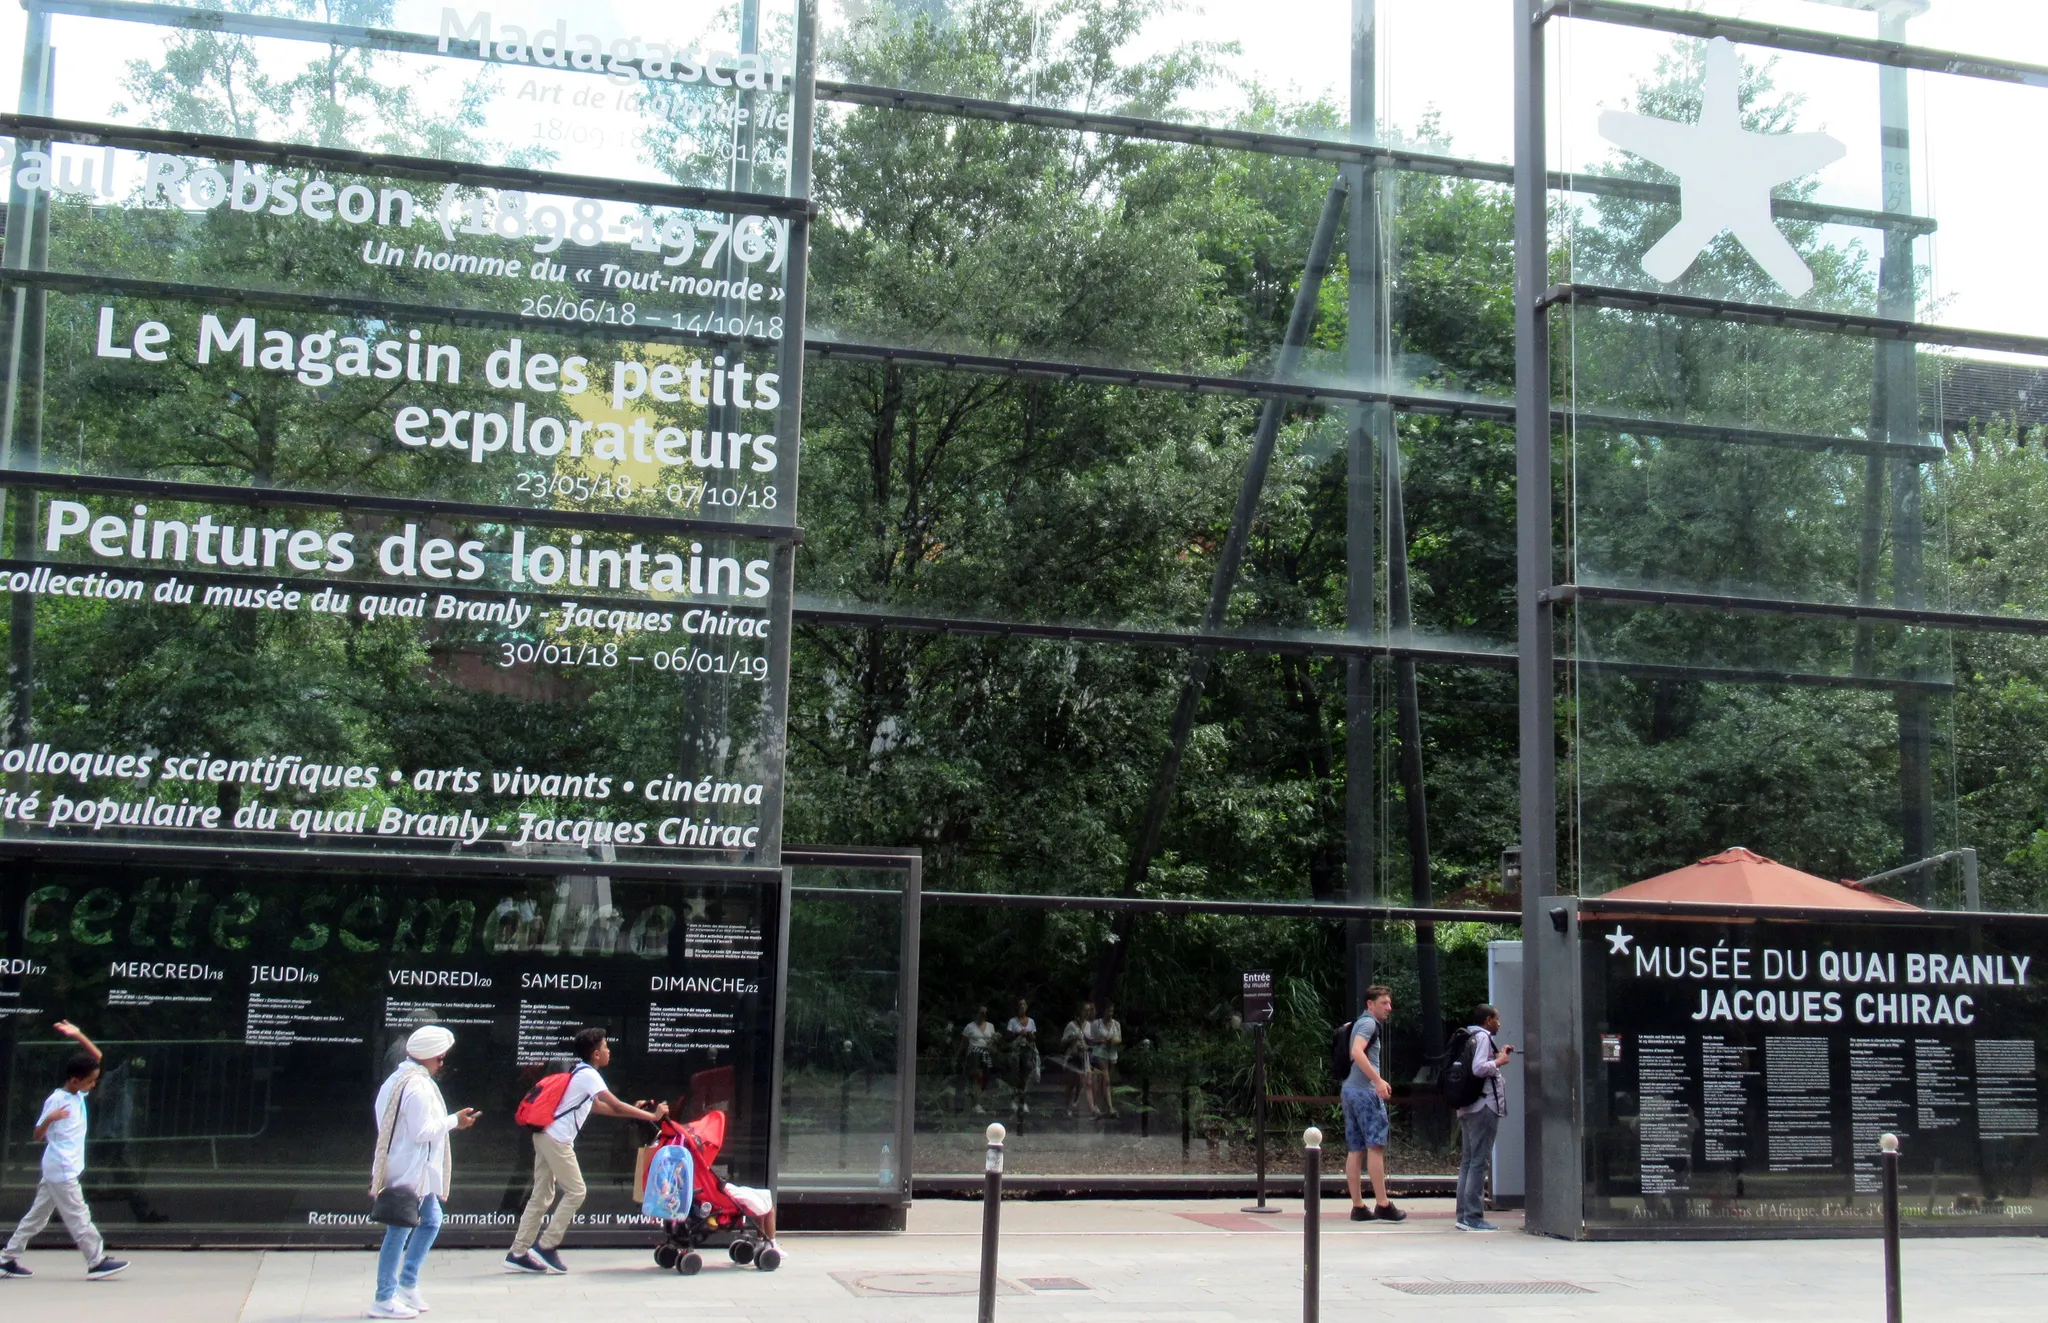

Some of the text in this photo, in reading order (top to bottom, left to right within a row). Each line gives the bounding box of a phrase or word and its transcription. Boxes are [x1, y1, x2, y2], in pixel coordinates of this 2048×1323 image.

[438, 7, 793, 93] Madagascar
[517, 79, 563, 104] Art
[572, 86, 606, 109] de
[144, 153, 414, 228] Robseon
[439, 182, 788, 273] (1898-1976)
[362, 240, 402, 267] Un
[414, 244, 520, 279] homme
[531, 256, 567, 283] du
[602, 263, 764, 302] Tout-monde
[520, 293, 637, 326] 26/06/18
[671, 309, 785, 339] 14/10/18
[97, 306, 782, 411] Le Magasin des petits
[394, 402, 779, 473] explorateurs
[516, 471, 633, 502] 23/05/18
[666, 482, 779, 510] 07/10/18
[46, 499, 772, 599] Peintures des lointains
[154, 577, 195, 604] du
[203, 583, 302, 611] musée
[311, 587, 351, 613] du
[358, 591, 427, 622] quai
[434, 594, 532, 630] Branly
[555, 602, 673, 634] Jacques
[681, 608, 771, 639] Chirac
[499, 639, 619, 668] 30/01/18
[653, 646, 770, 682] 06/01/19
[0, 744, 764, 806] olloques scientifiques arts vivants cinéma
[48, 795, 223, 831] populaire
[233, 801, 280, 831] du
[289, 805, 369, 838] quai
[376, 806, 490, 846] Branly
[511, 812, 648, 849] Jacques
[657, 816, 761, 849] Chirac
[110, 961, 225, 981] MERCREDI/18
[249, 965, 320, 985] JEUDI/19
[388, 970, 493, 987] VENDREDI/20
[521, 972, 603, 990] SAMEDI/21
[1243, 972, 1272, 982] Entrée
[1636, 939, 2031, 986] MUSÉE DU QUAI BRANLY
[651, 976, 760, 993] DIMANCHE/22
[1252, 981, 1271, 989] musée
[1691, 989, 1975, 1025] JACQUES CHIRAC
[590, 1213, 612, 1225] sur
[1756, 1202, 1820, 1221] d'Afrique,
